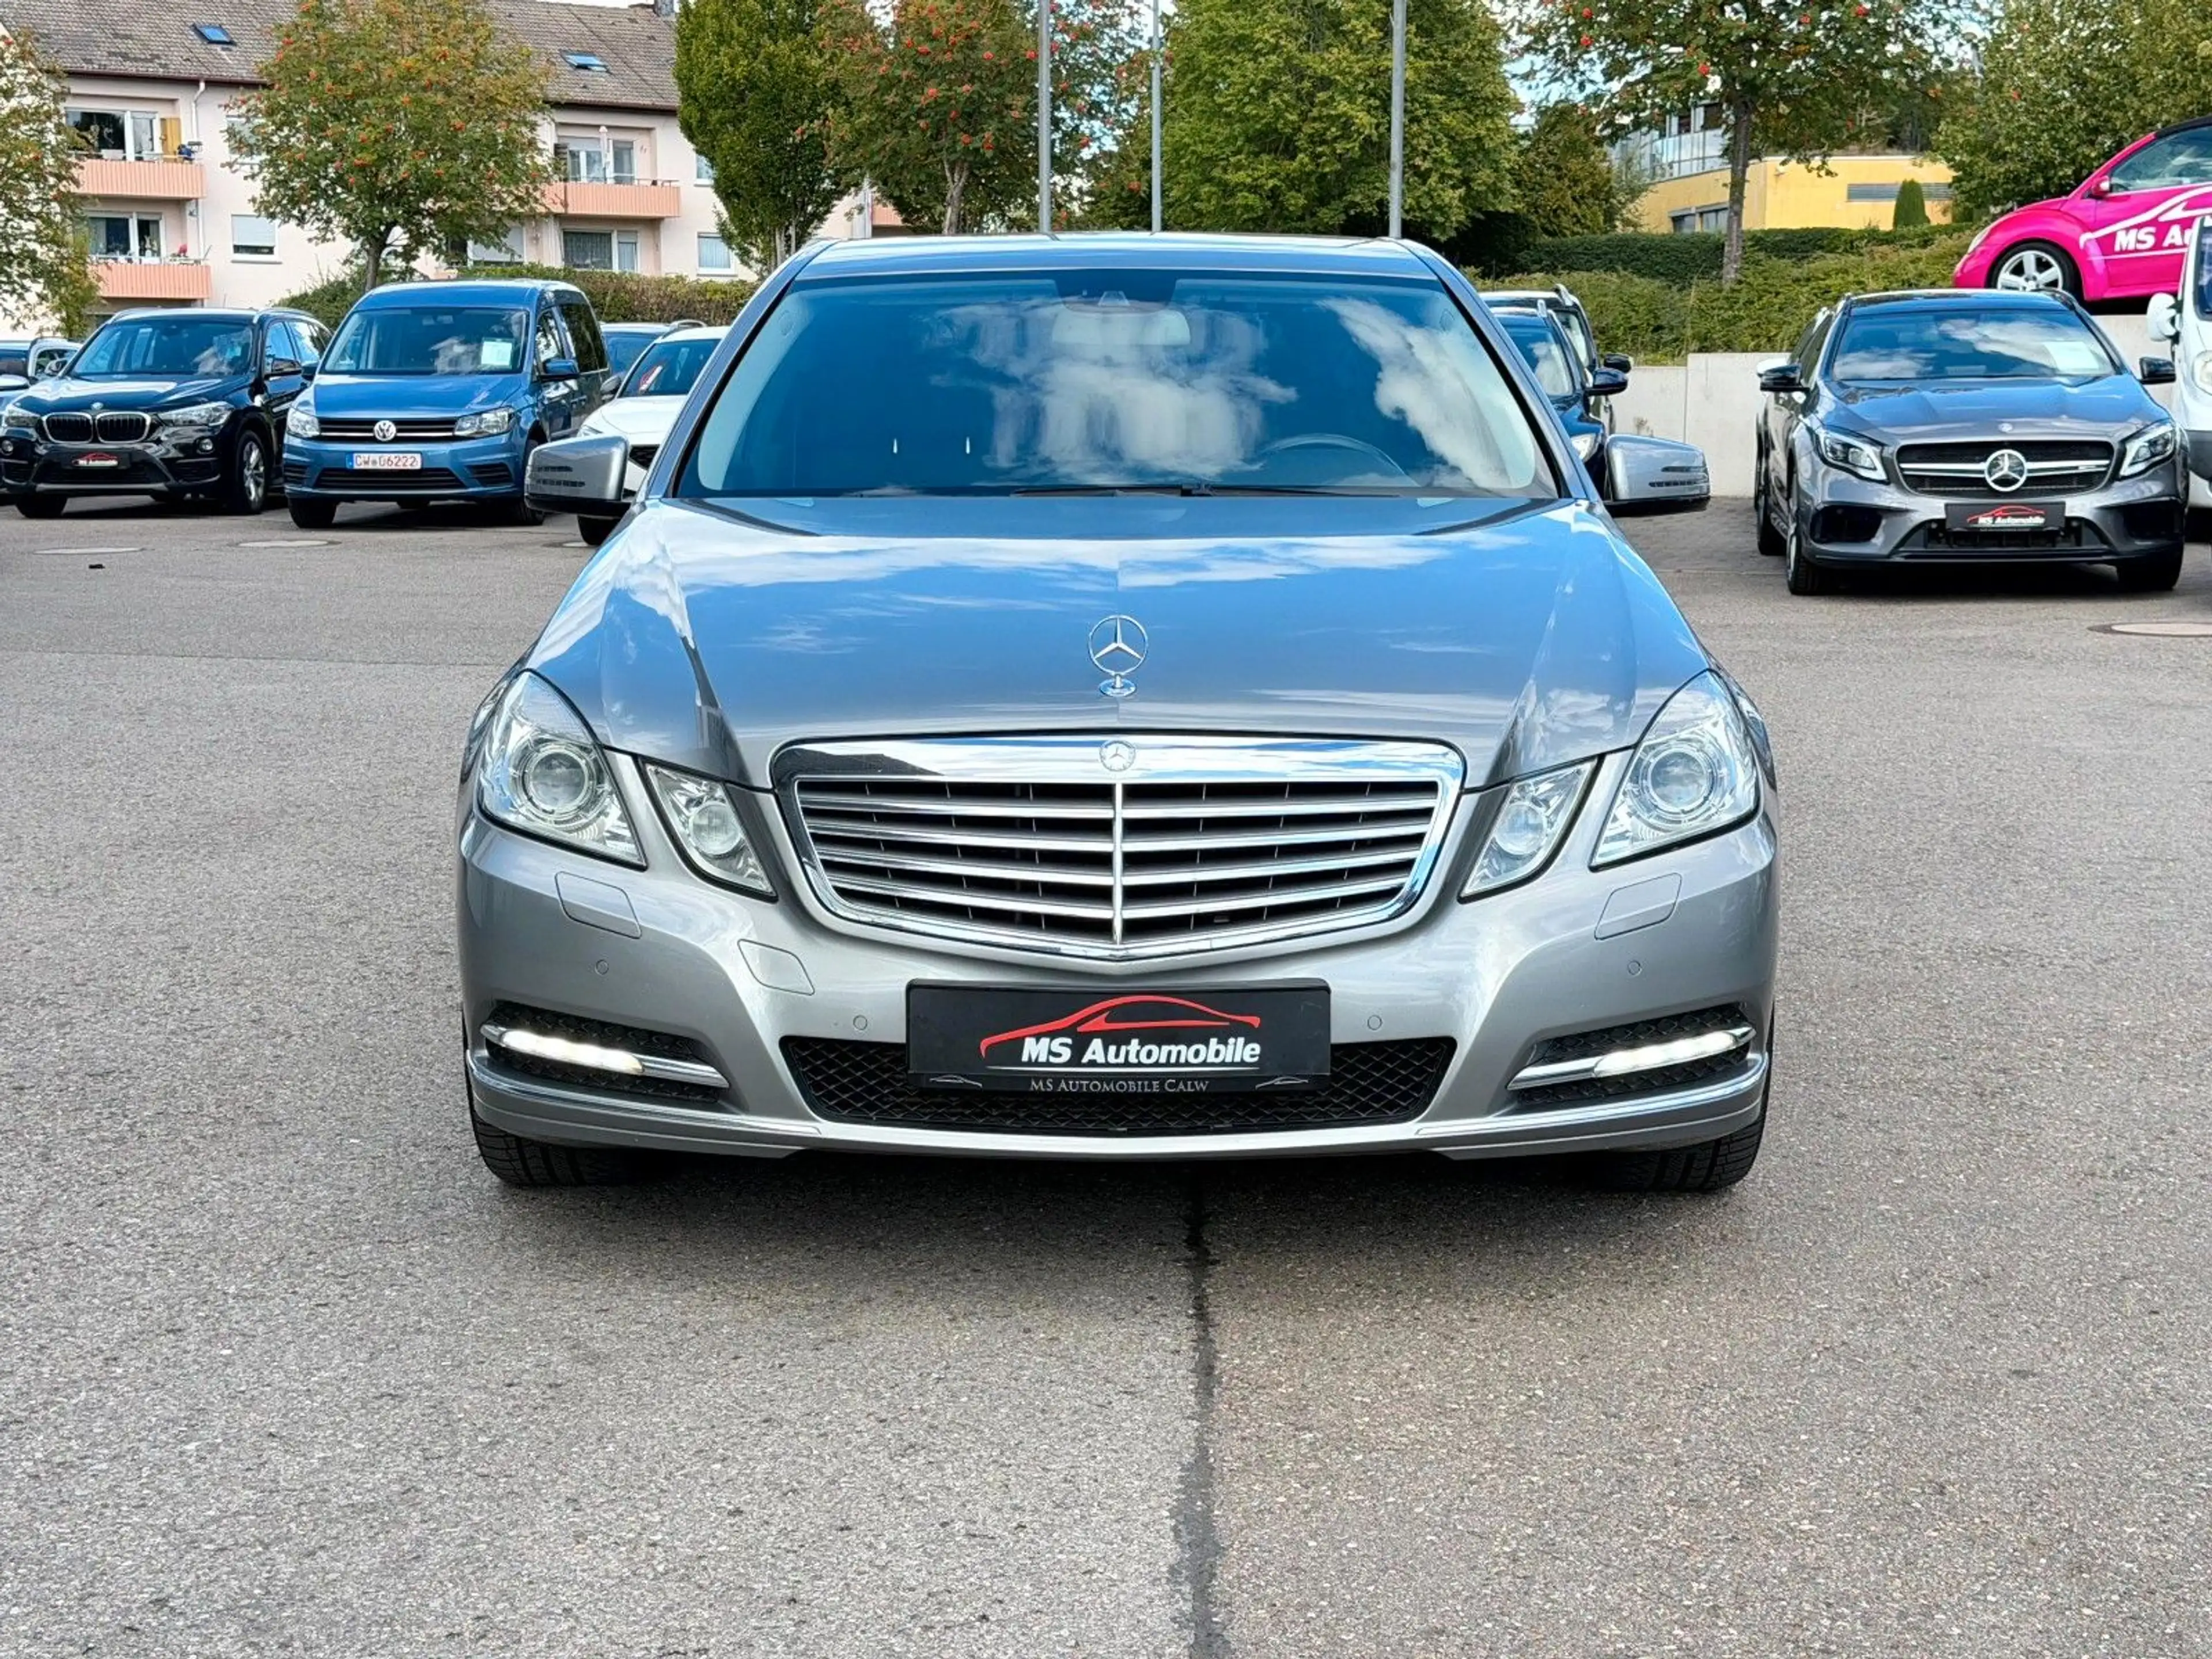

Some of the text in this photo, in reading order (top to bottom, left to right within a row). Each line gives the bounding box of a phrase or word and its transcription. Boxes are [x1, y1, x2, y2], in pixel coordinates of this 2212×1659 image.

[2114, 226, 2157, 252] MS
[355, 454, 370, 466] CW
[1021, 1037, 1261, 1064] MS Automobile
[1029, 1078, 1053, 1092] MS
